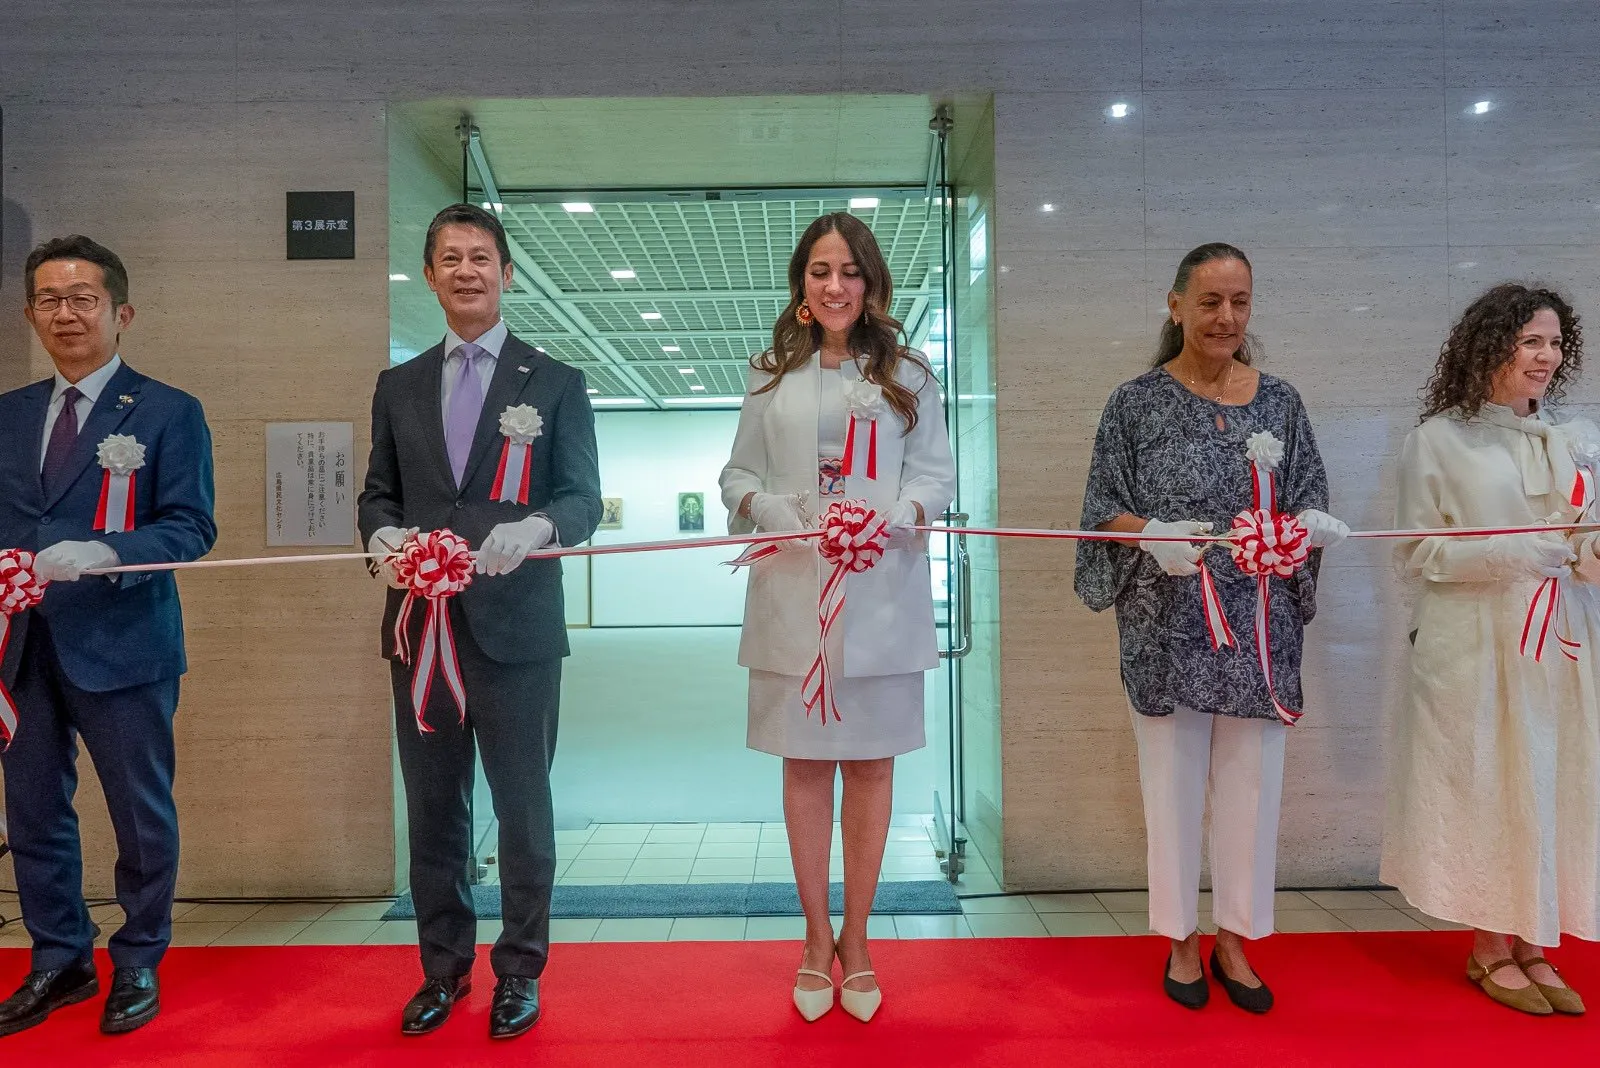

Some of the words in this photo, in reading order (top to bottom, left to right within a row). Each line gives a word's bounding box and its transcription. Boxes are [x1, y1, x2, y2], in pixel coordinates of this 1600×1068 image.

[292, 219, 348, 231] 第3展示室
[335, 452, 345, 505] お願い
